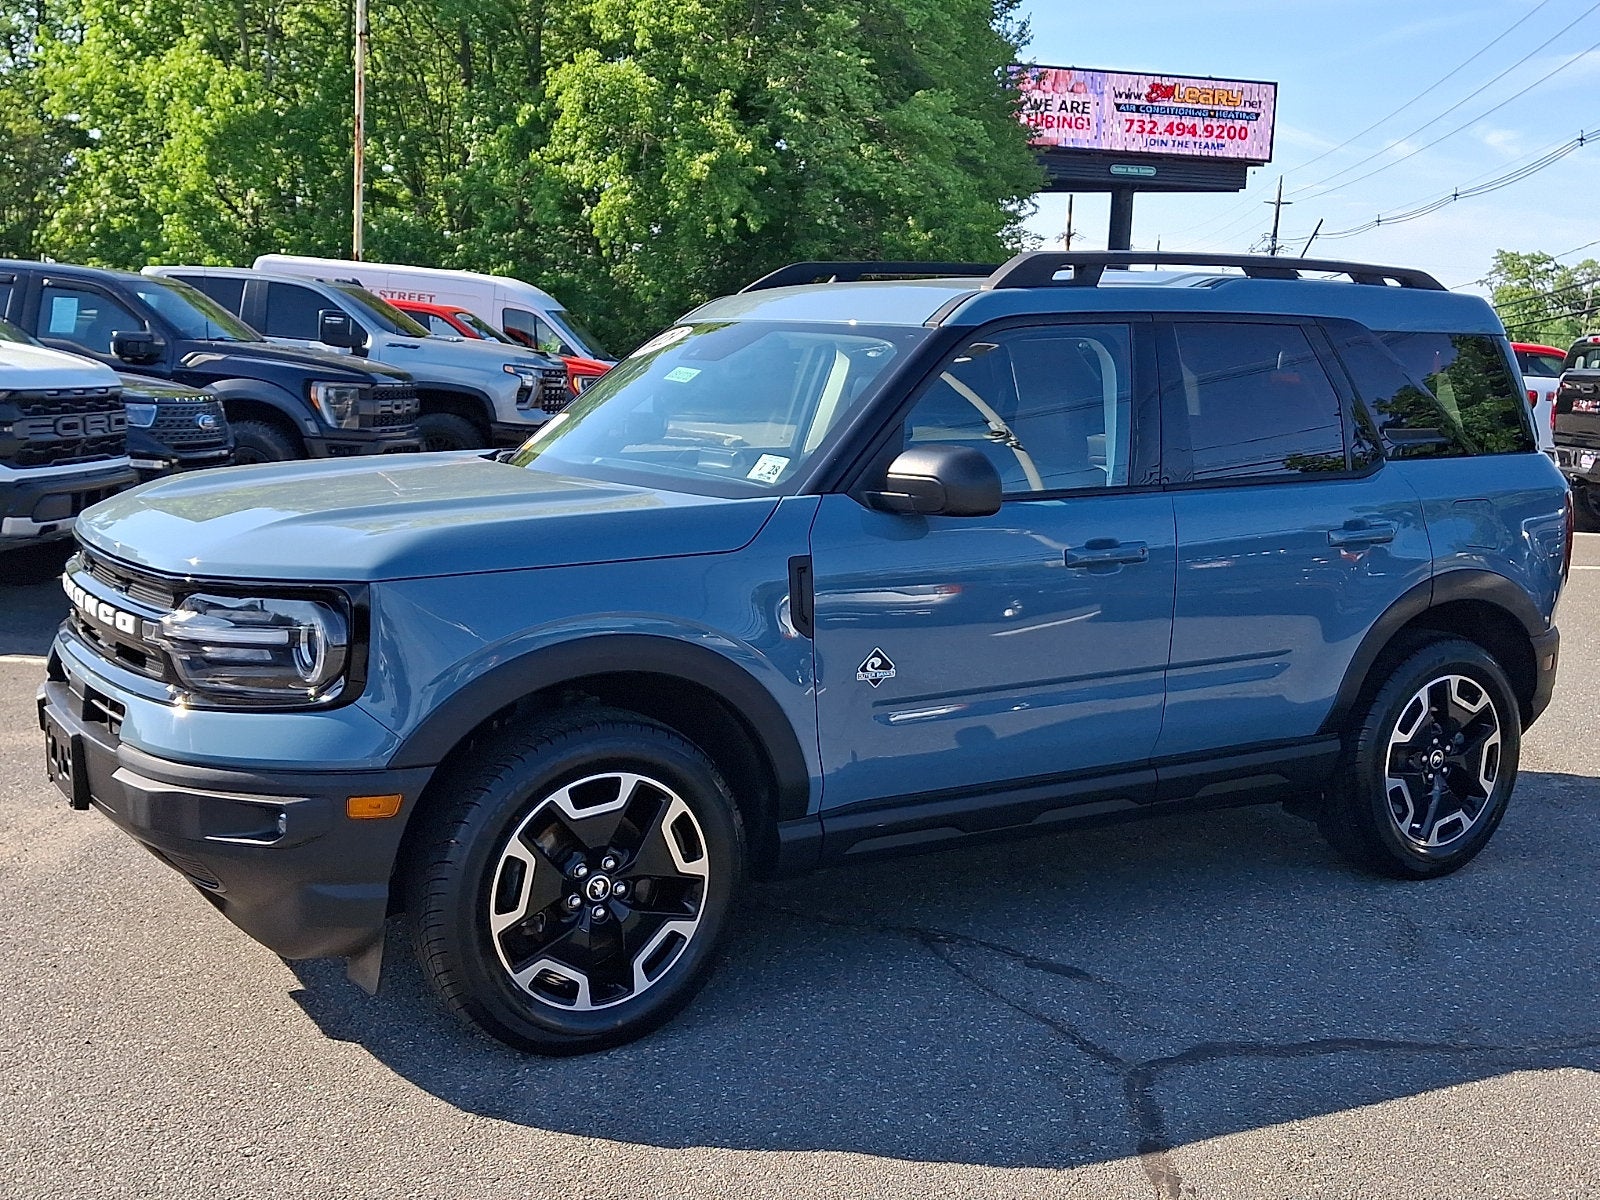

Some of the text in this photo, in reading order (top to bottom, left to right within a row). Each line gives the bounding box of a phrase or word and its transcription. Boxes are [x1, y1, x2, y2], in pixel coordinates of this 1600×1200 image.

[1028, 98, 1091, 114] WE ARE
[1119, 104, 1257, 120] AIR CONDITIONING HEATING
[1125, 119, 1249, 141] 732.494.9200
[1144, 138, 1169, 148] JOIN
[1170, 139, 1190, 148] THE
[379, 289, 436, 303] STREET
[18, 411, 128, 438] FORD
